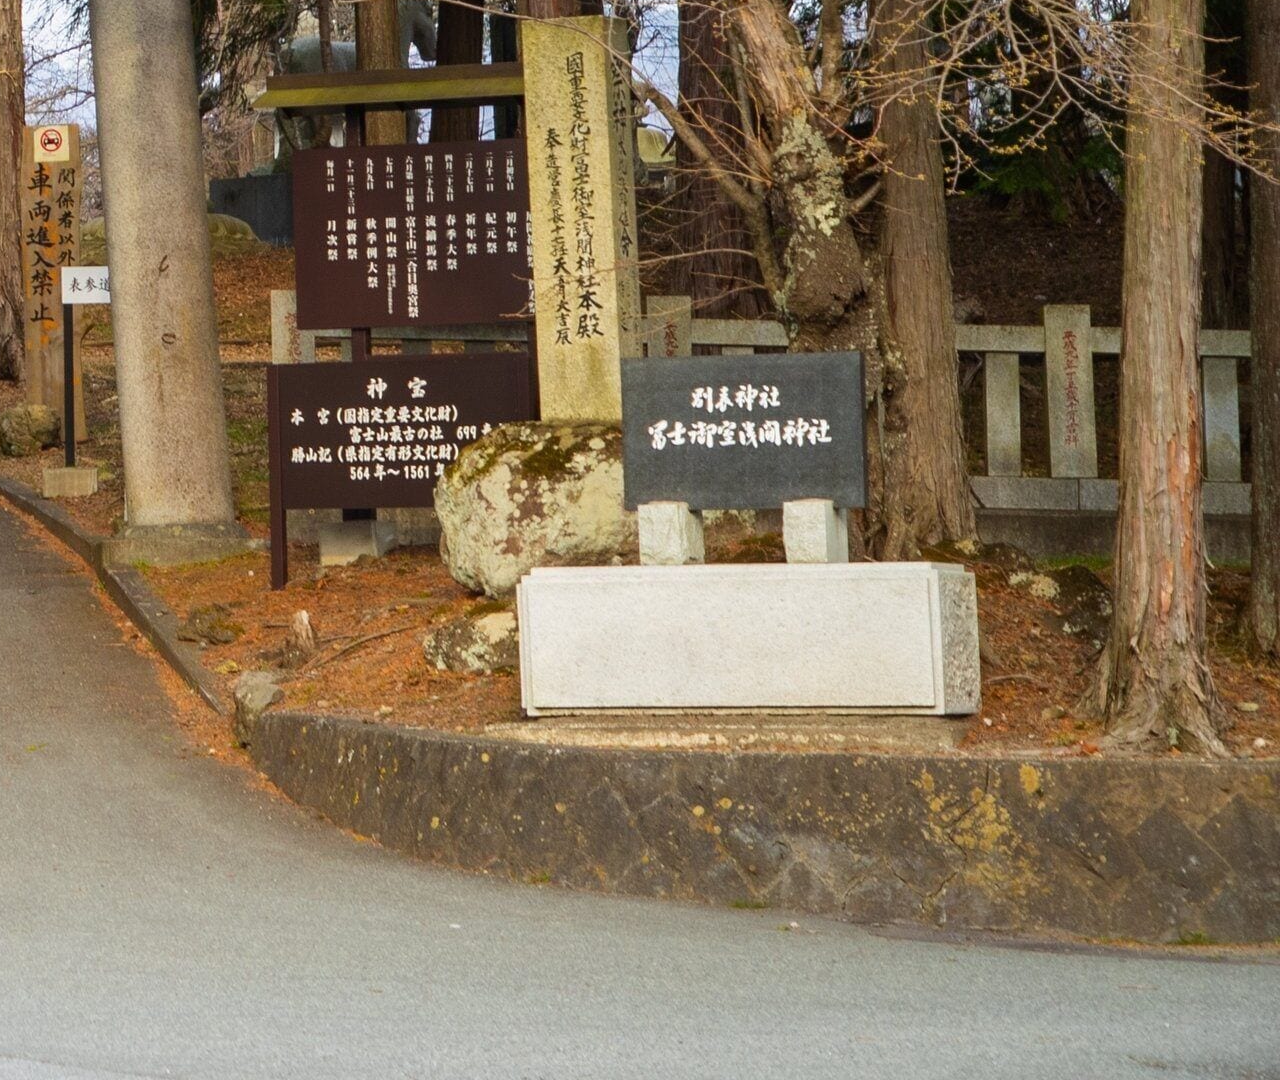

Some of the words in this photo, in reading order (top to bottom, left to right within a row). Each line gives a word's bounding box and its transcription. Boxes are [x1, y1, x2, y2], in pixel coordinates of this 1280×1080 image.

[26, 163, 57, 322] 車両進入禁止
